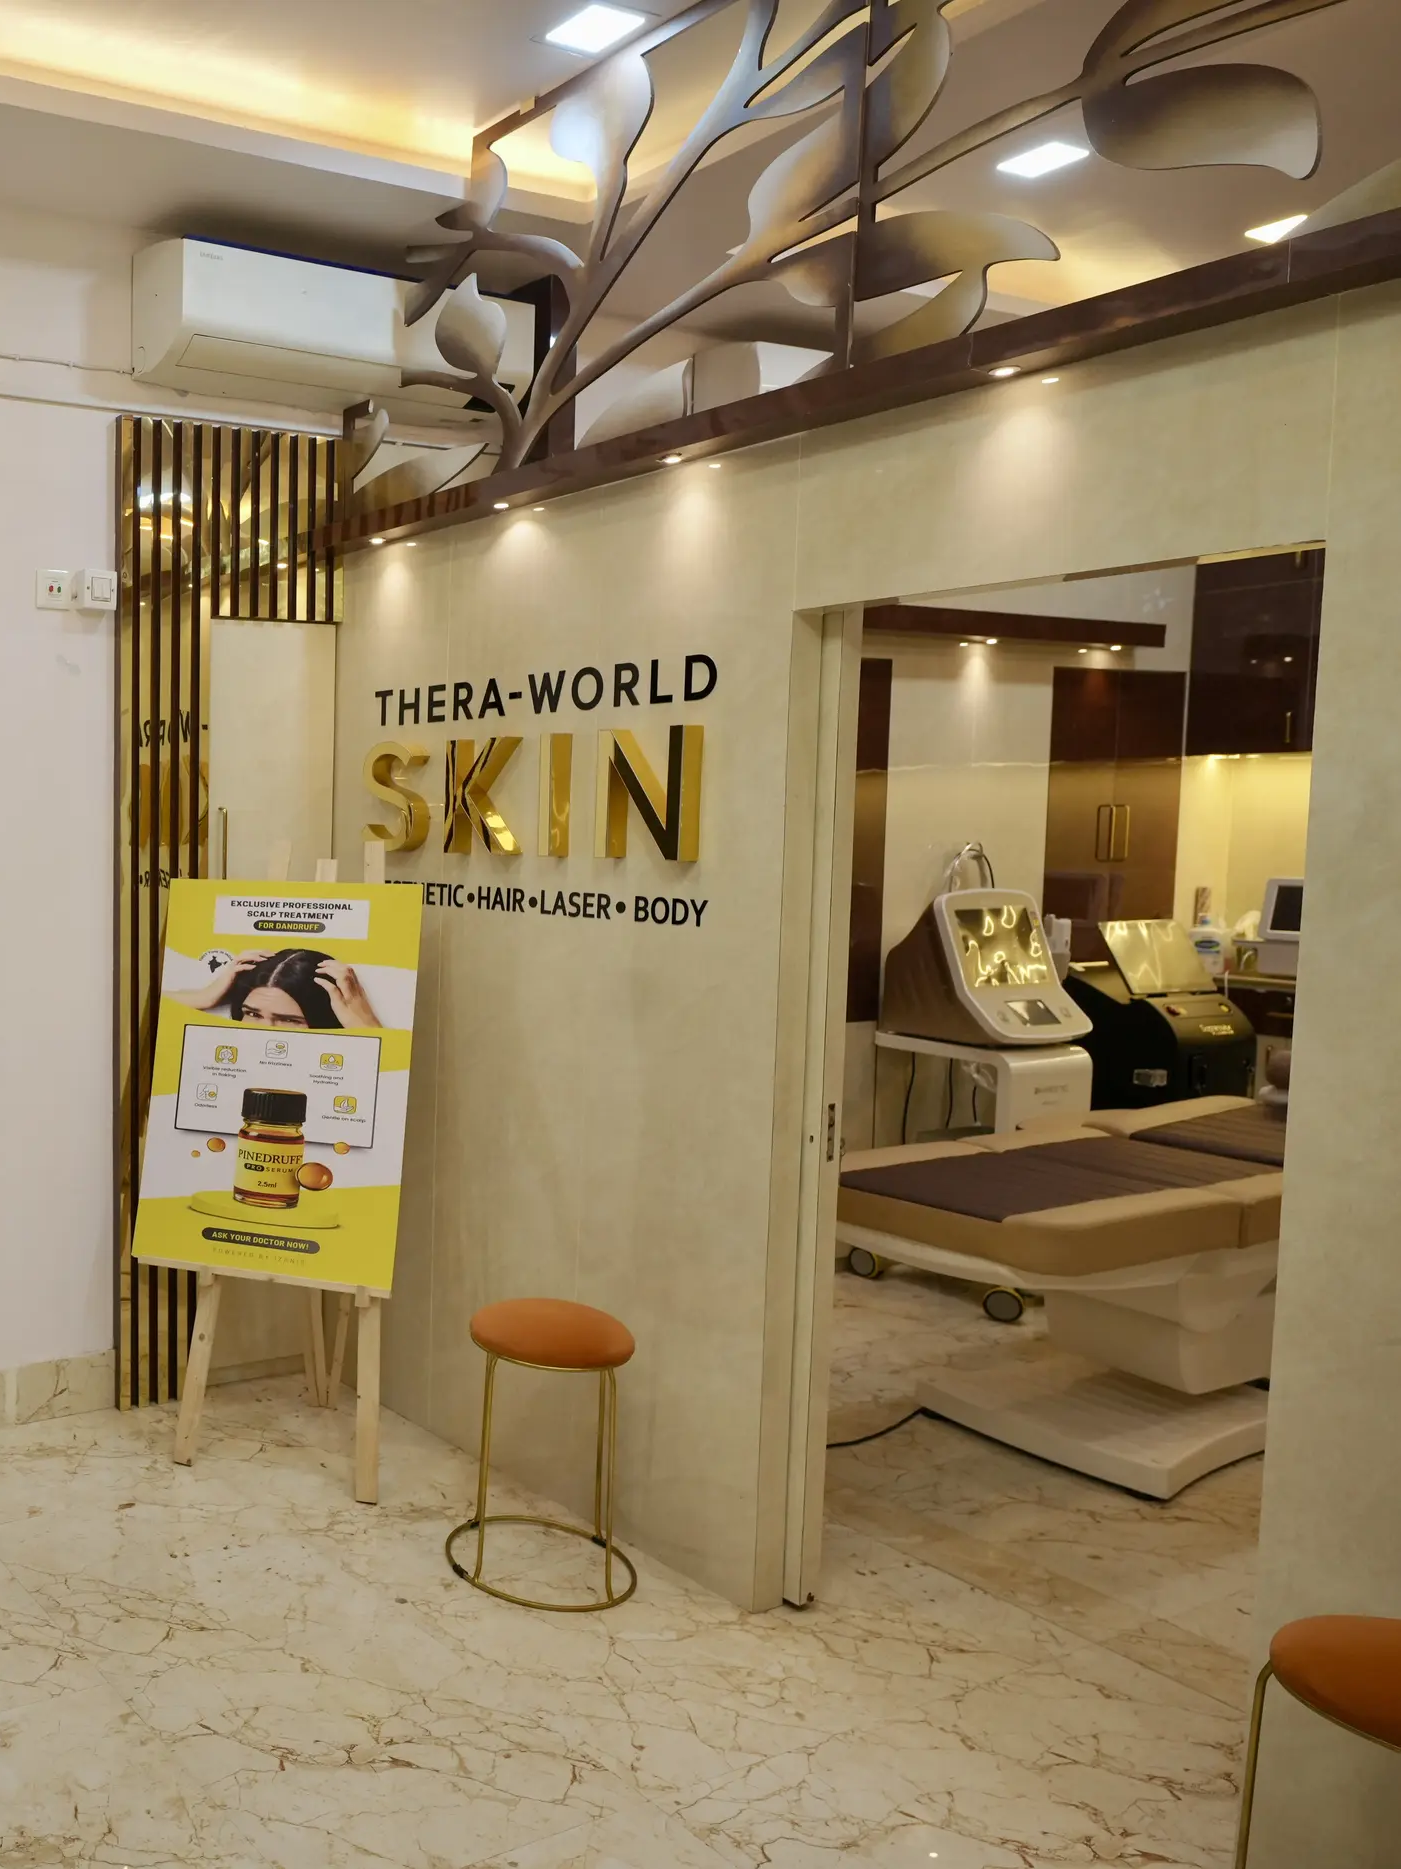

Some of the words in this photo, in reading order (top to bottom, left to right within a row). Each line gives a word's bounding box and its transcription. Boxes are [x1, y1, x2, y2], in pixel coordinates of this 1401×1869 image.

[375, 654, 718, 726] THERA-WORLD
[362, 725, 705, 862] SKIN
[230, 900, 281, 909] EXCLUSIVE
[283, 901, 353, 911] PROFESSIONAL
[477, 886, 525, 913] HAIR
[540, 889, 611, 920] LASER
[634, 896, 709, 927] BODY
[247, 910, 277, 918] SCALP
[279, 911, 334, 920] TREATMENT
[258, 922, 274, 930] FOR
[275, 922, 320, 931] DANDRUFF
[257, 1180, 277, 1188] 2.5ml
[212, 1231, 228, 1239] ASK
[230, 1233, 251, 1243] YOUR
[252, 1236, 285, 1247] DOCTOR
[286, 1241, 309, 1250] NOW!
